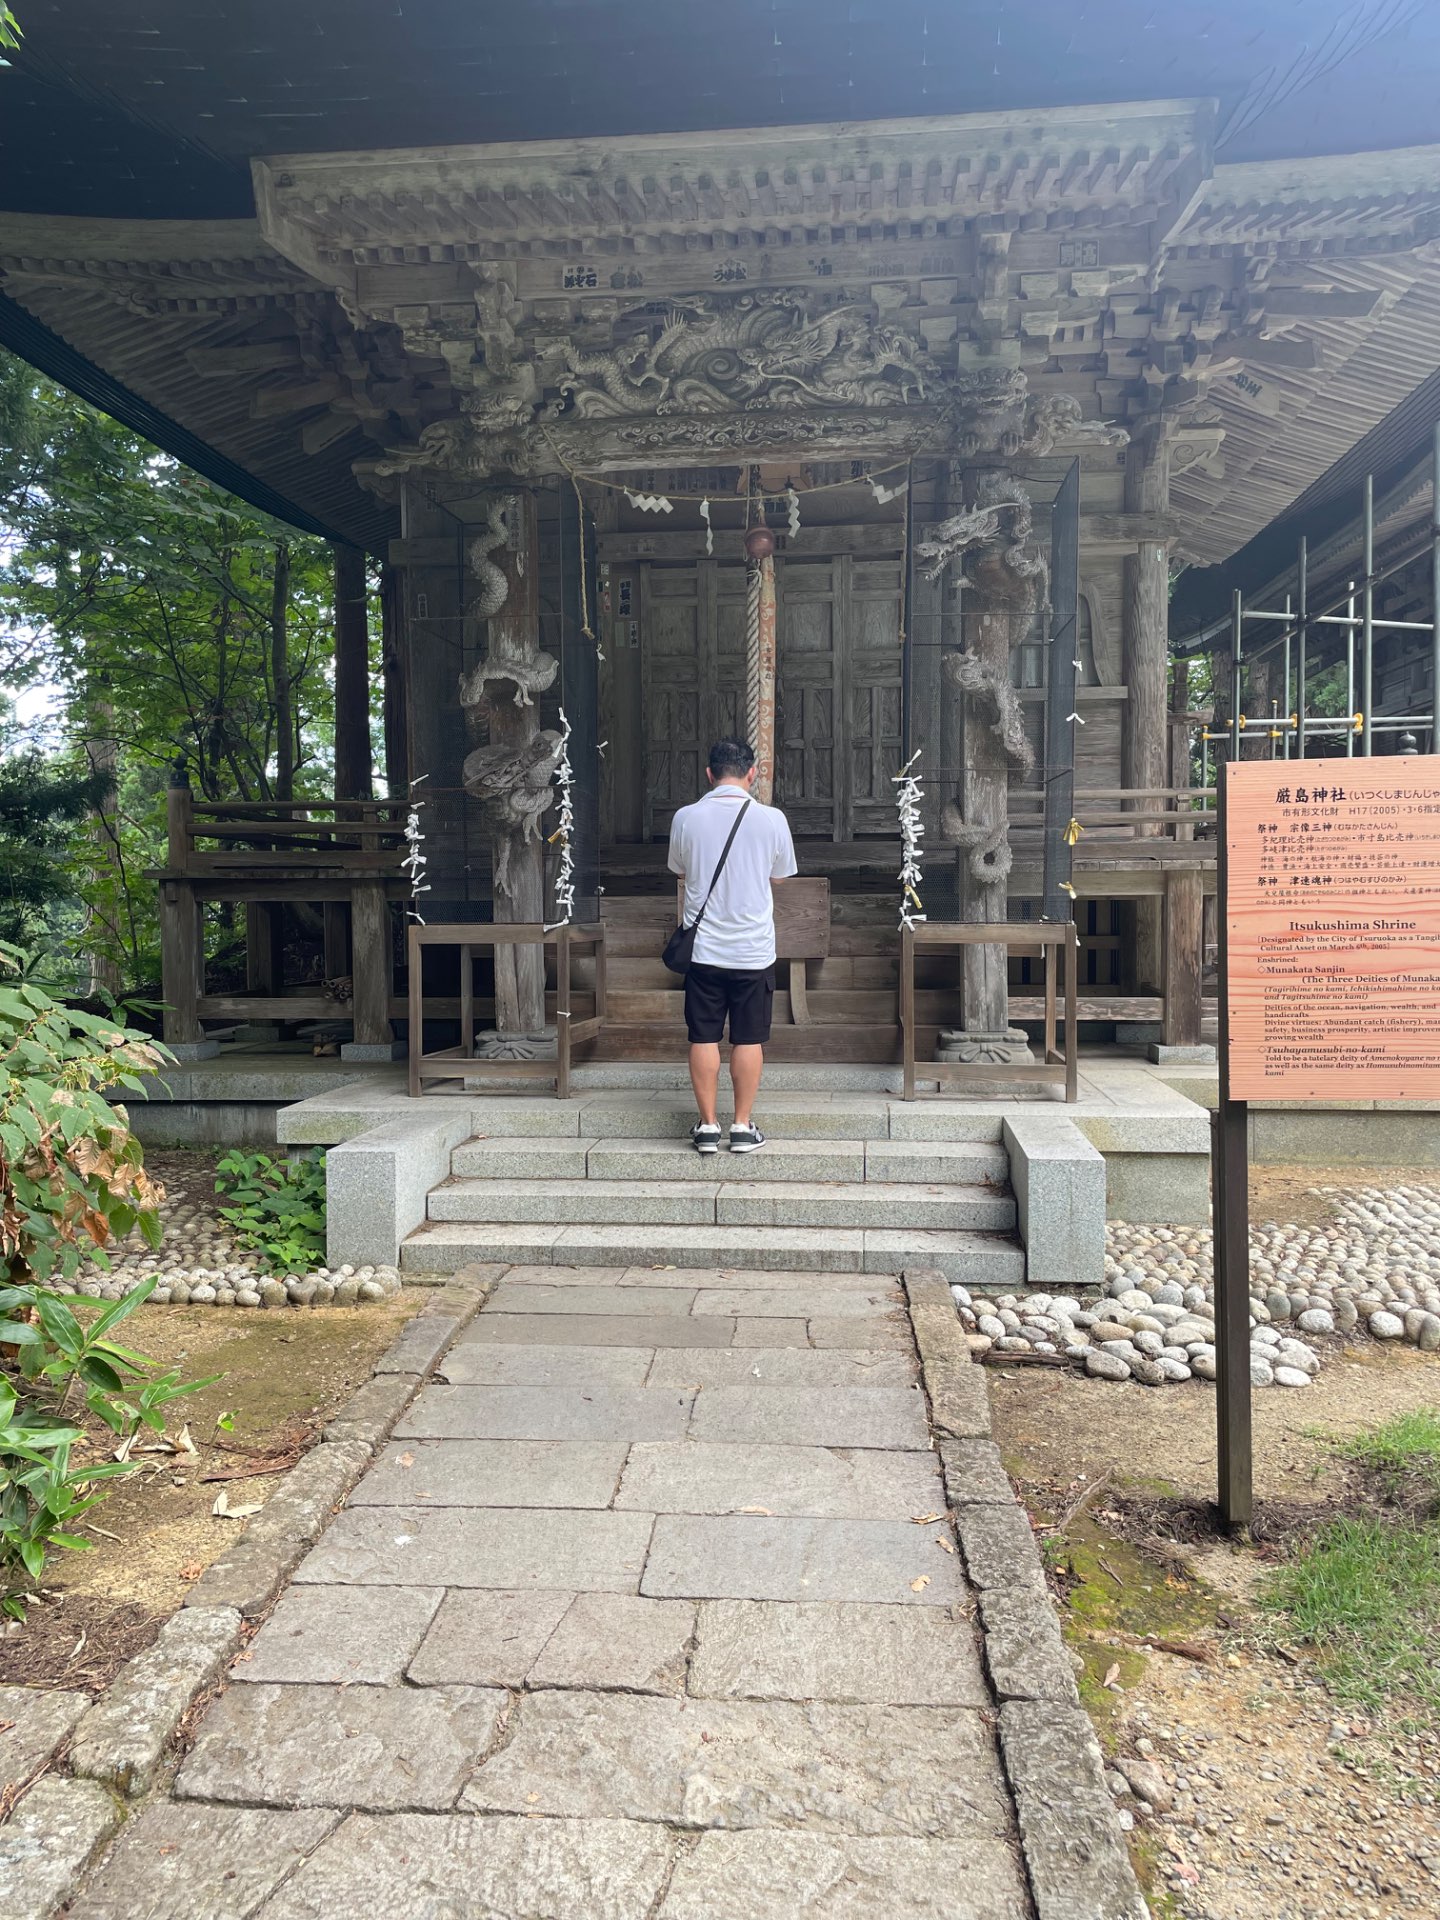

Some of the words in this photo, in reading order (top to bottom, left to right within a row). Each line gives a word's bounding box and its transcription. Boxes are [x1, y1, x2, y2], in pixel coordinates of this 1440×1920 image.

[1282, 807, 1339, 818] 市有形文化財
[1289, 920, 1370, 931] Itsukushima
[1372, 919, 1416, 930] Shrine
[1306, 935, 1316, 943] by
[1315, 966, 1345, 974] Sanjin
[1302, 976, 1324, 984] (The
[1356, 975, 1388, 983] Deities
[1386, 1018, 1424, 1026] (fishery),
